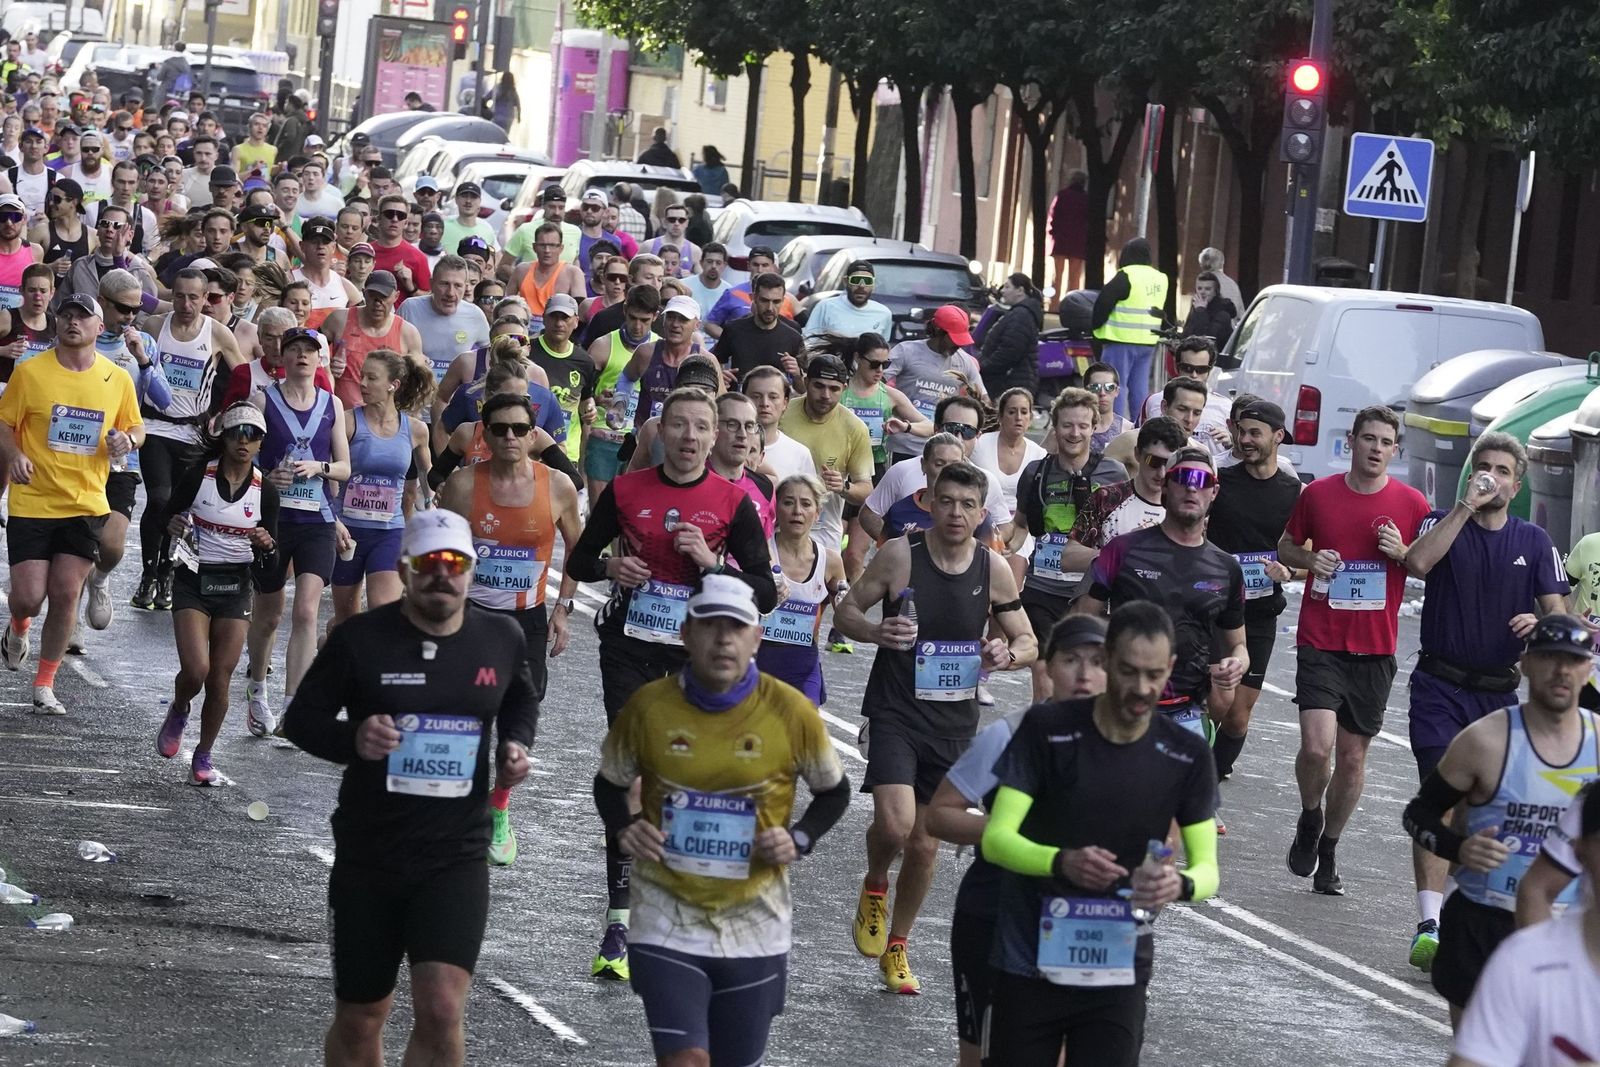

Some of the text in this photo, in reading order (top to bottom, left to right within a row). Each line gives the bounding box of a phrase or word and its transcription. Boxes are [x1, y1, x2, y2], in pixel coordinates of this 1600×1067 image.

[174, 357, 199, 367] ZURICH
[166, 375, 193, 389] ASCAL
[915, 379, 957, 395] MARIANO
[70, 409, 99, 419] ZURICH
[58, 431, 91, 444] KEMPY
[351, 498, 388, 510] CHATON
[494, 548, 529, 558] ZURICH
[493, 564, 513, 573] 7139
[1244, 578, 1264, 588] LEX
[1349, 577, 1366, 585] 7068
[653, 584, 690, 599] ZURICH
[1351, 588, 1363, 598] PL
[651, 602, 671, 614] 6120
[784, 602, 813, 613] ZURICH
[627, 608, 680, 633] MARINEL
[780, 616, 796, 626] 8954
[773, 627, 812, 643] GUINDOS
[940, 644, 976, 654] ZURICH
[940, 662, 960, 671] 6212
[938, 674, 961, 687] FER
[424, 718, 474, 731] ZURICH
[402, 757, 464, 777] HASSEL
[694, 795, 747, 812] ZURICH
[684, 836, 751, 858] CUERPO
[1075, 903, 1125, 916] ZURICH
[1068, 946, 1108, 964] TONI
